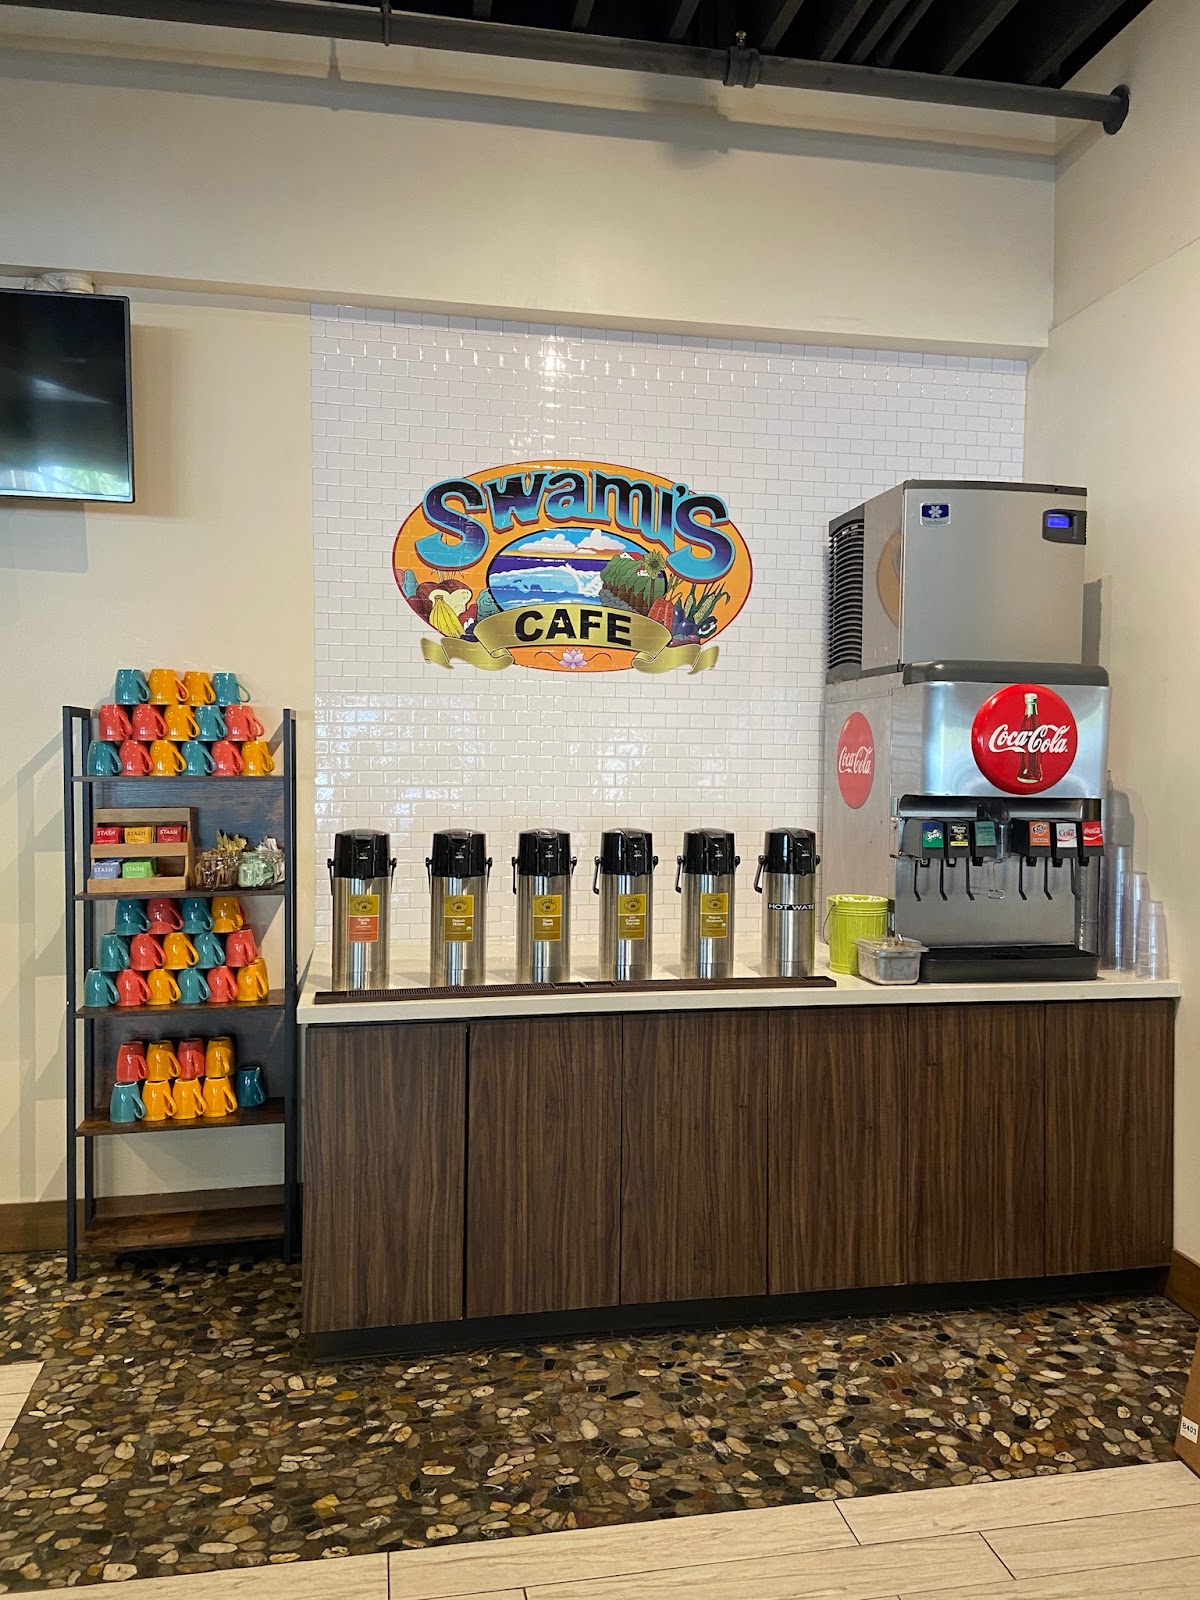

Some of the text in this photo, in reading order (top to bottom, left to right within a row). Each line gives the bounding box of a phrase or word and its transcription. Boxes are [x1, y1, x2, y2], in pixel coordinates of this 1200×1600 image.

[515, 608, 631, 647] CAFE
[988, 723, 1071, 753] Coca-Cola
[838, 746, 873, 775] Coca-Cola
